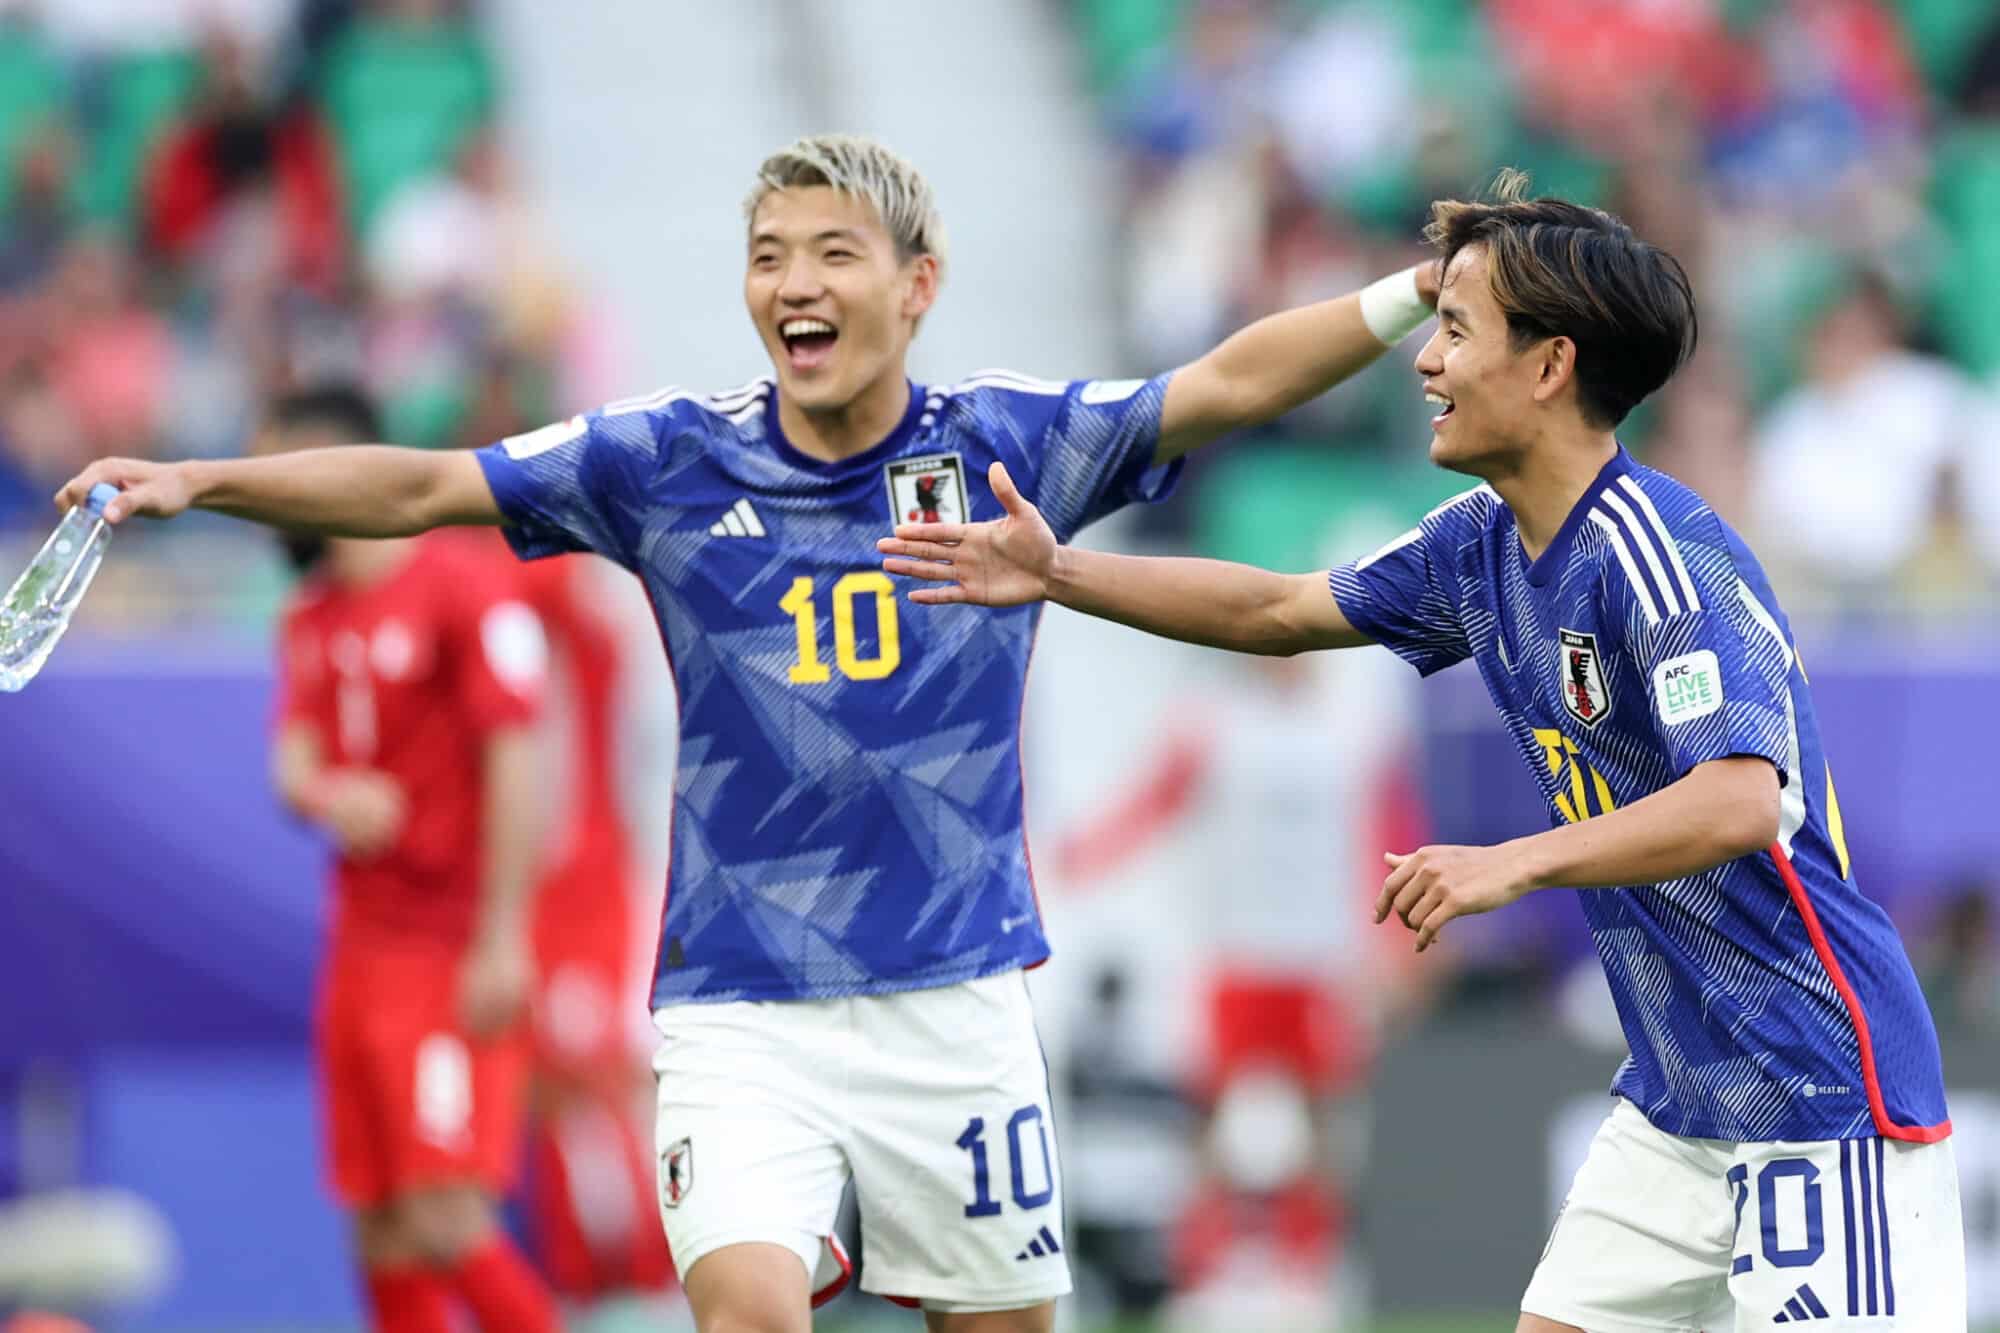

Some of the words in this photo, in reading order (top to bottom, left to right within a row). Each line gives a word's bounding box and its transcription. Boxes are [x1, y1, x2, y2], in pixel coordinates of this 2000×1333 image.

[778, 571, 900, 685] 10
[1665, 664, 1689, 681] AFC
[1665, 671, 1710, 698] LIVE
[955, 1104, 1053, 1218] 10
